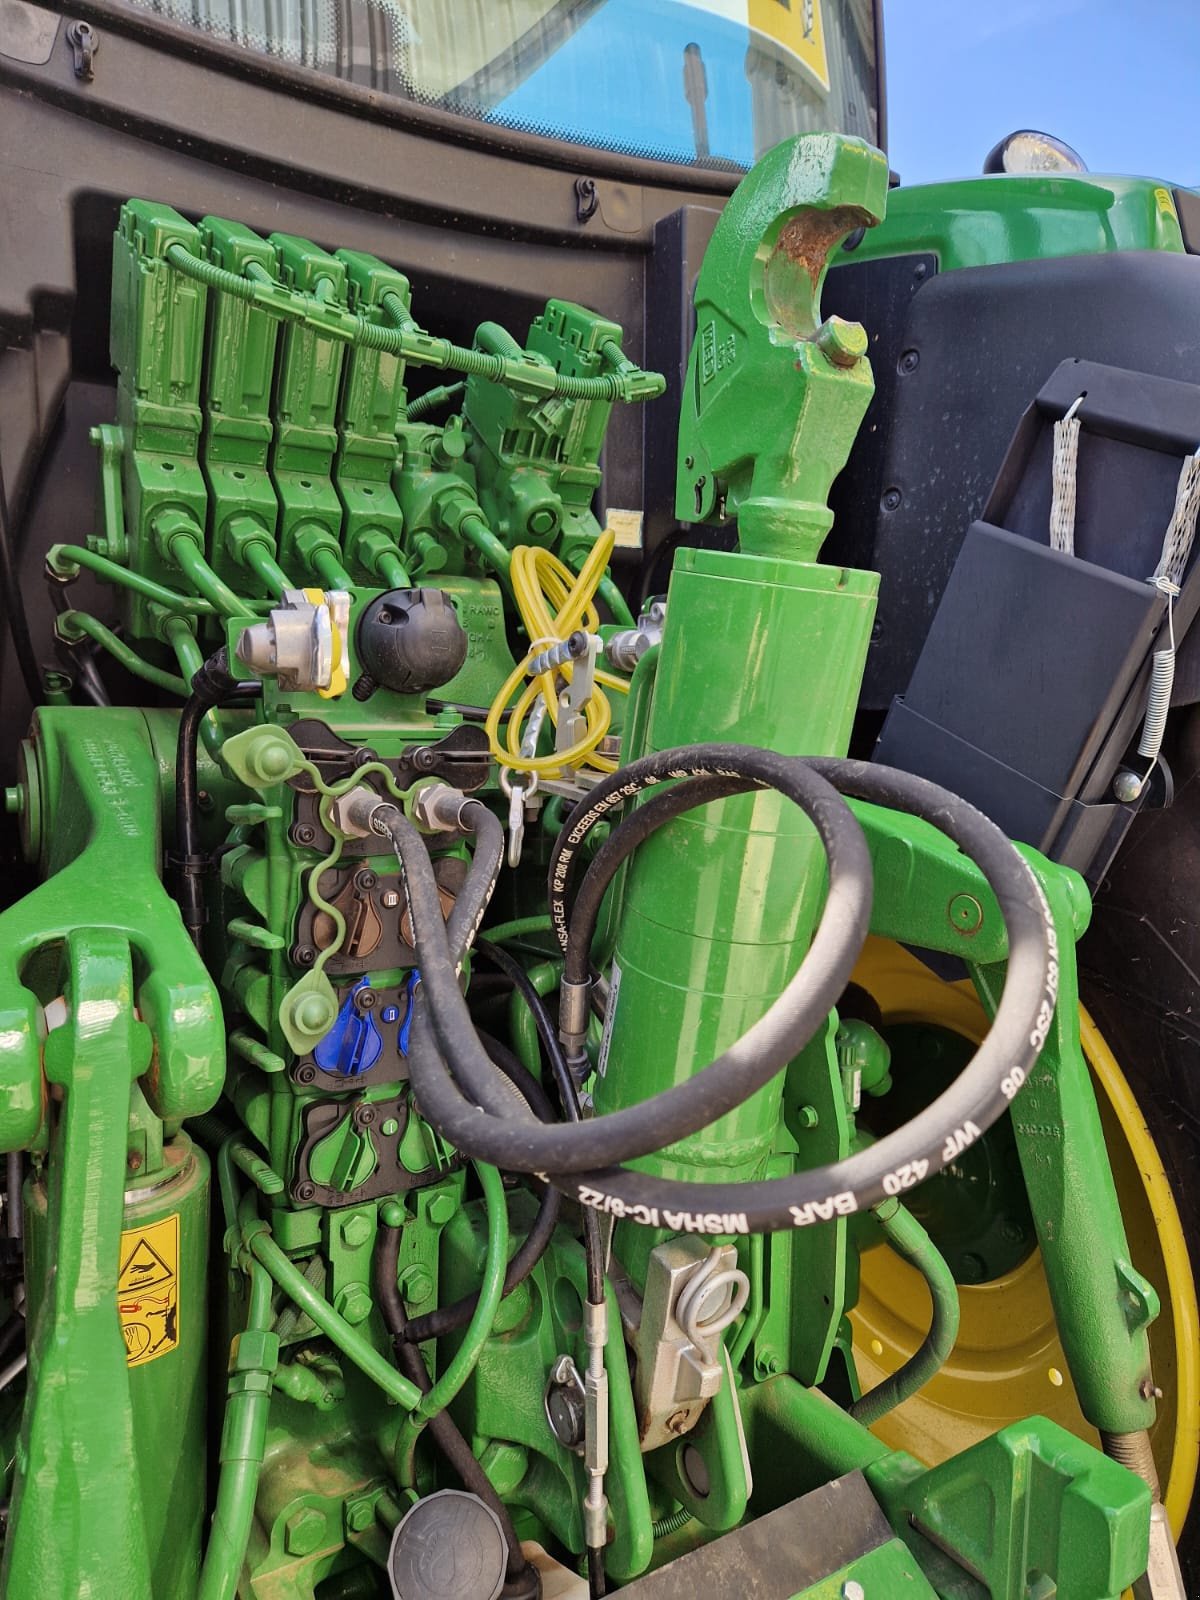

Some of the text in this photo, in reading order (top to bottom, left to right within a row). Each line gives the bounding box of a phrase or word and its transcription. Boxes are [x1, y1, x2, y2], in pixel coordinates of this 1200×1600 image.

[597, 801, 611, 813] EN
[606, 792, 623, 805] 857
[567, 809, 600, 844] EXCEEDS
[557, 863, 569, 879] 208
[560, 848, 574, 864] RM
[554, 879, 565, 893] KP
[554, 900, 568, 951] ANSA-FLEX
[1000, 1065, 1026, 1100] 08
[942, 1120, 981, 1162] WP
[882, 1158, 930, 1195] 420
[662, 1209, 750, 1234] MSHA
[788, 1190, 859, 1226] BAR
